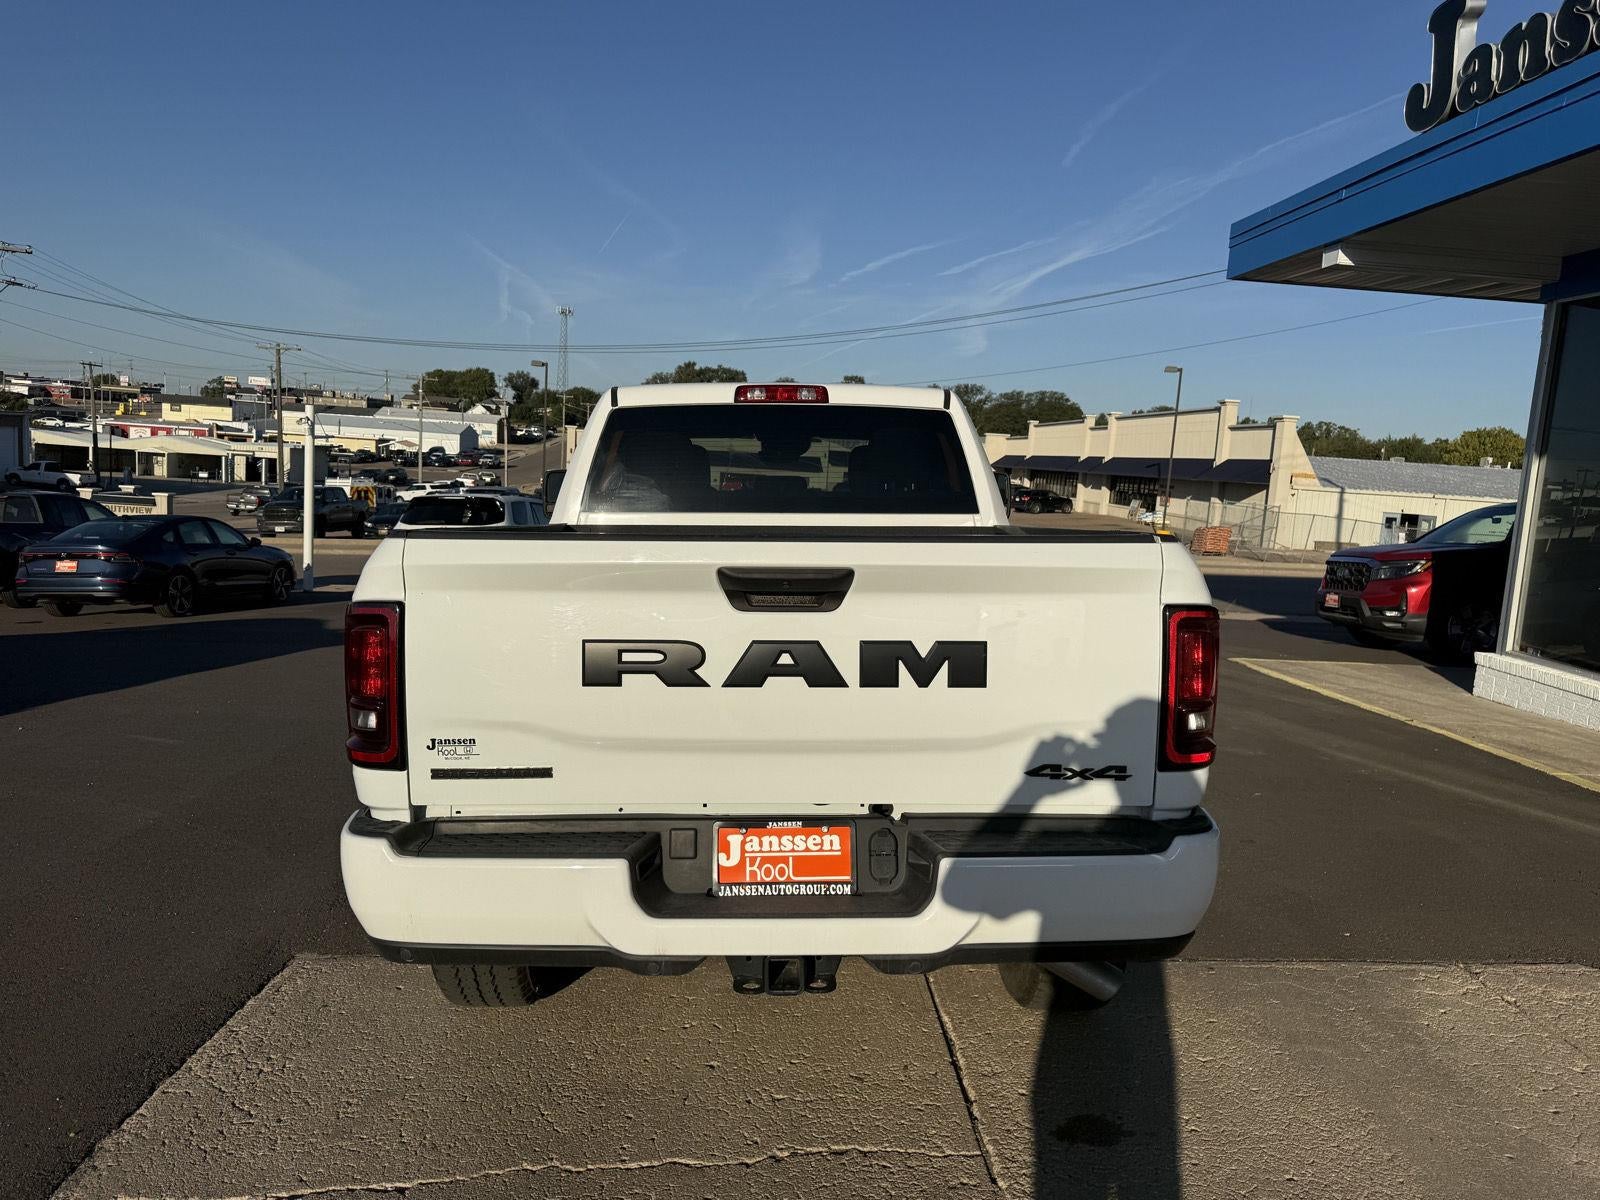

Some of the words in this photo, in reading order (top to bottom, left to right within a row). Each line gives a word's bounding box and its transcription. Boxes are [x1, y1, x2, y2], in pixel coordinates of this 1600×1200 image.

[1404, 0, 1600, 133] Jans
[582, 639, 988, 688] RAM
[426, 738, 476, 751] Janssen
[437, 746, 460, 756] Kool
[1024, 764, 1133, 781] 4x4
[767, 821, 802, 829] JANSSEN
[719, 834, 841, 867] Janssen
[745, 857, 800, 881] Kool
[718, 884, 852, 897] JANSSENAUTOGROUP.COM
